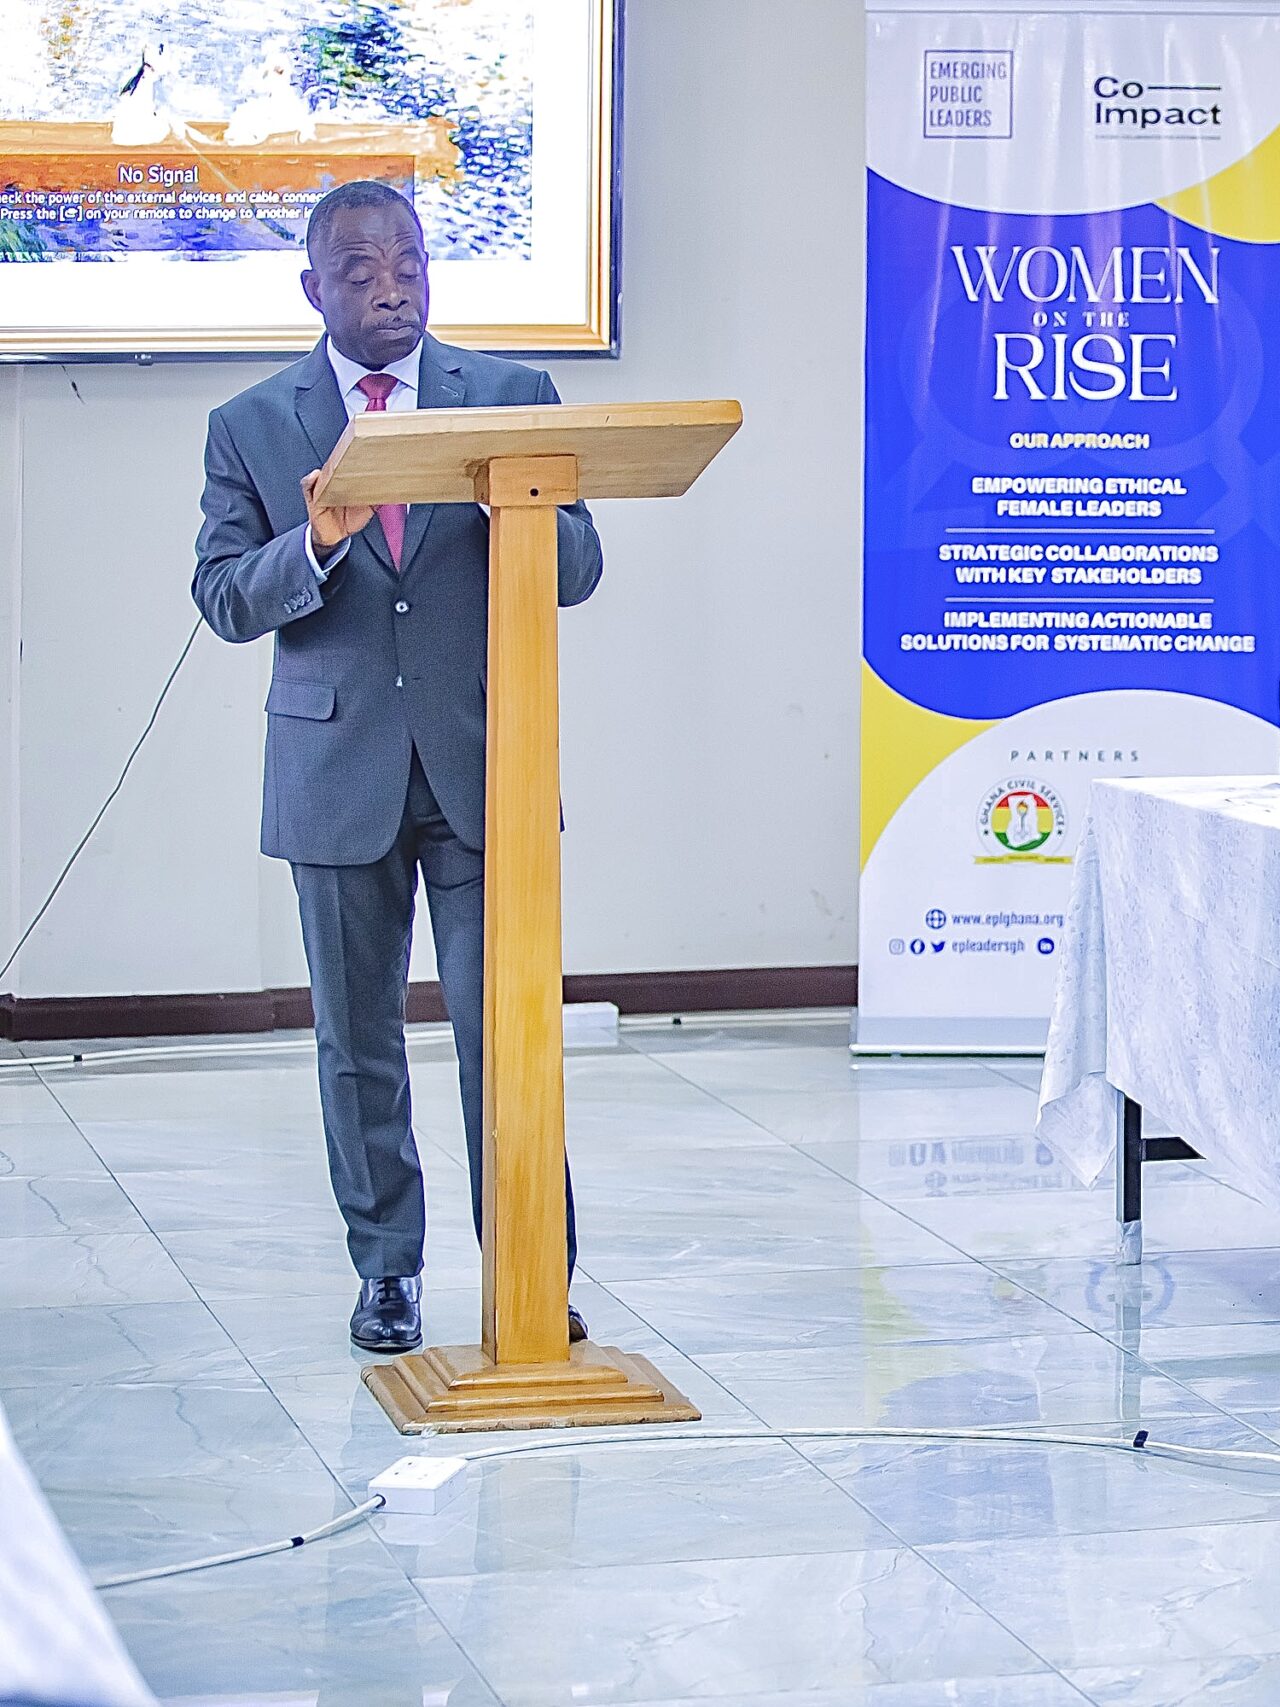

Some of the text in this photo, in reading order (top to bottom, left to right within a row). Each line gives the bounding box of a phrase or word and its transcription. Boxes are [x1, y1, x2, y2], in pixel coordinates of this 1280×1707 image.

[930, 62, 1006, 79] EMERGING
[930, 86, 982, 102] PUBLIC
[929, 110, 991, 126] LEADERS
[1095, 103, 1221, 128] Impact
[120, 166, 198, 187] No Signal
[0, 192, 21, 203] eck
[26, 192, 48, 203] the
[49, 194, 85, 206] power
[88, 192, 101, 203] of
[104, 192, 124, 203] the
[127, 192, 175, 203] external
[179, 192, 222, 203] devices
[226, 192, 246, 203] and
[250, 192, 276, 203] cable
[1, 209, 32, 219] Press
[36, 208, 55, 219] the
[86, 210, 100, 219] on
[104, 210, 130, 221] your
[133, 209, 175, 219] remote
[179, 208, 192, 219] to
[196, 208, 236, 222] change
[240, 208, 252, 219] to
[256, 208, 301, 219] another
[951, 246, 1220, 303] WOMEN
[1033, 312, 1129, 327] ON THE
[993, 333, 1177, 400] RISE
[1010, 434, 1149, 449] OUR APPROACH
[973, 478, 1186, 494] EMPOWERING ETHICAL
[997, 500, 1161, 516] FEMALE LEADERS
[939, 545, 1218, 561] STRATEGIC COLLABORATIONS
[956, 568, 1201, 584] WITH KEY STAKEHOLDERS
[944, 612, 1212, 629] IMPLEMENTING ACTIONABLE
[900, 635, 1255, 652] SOLUTIONS FOR SYSTEMATIC CHANGE
[1010, 751, 1139, 762] PARTNERS
[1007, 780, 1035, 790] CIVIL
[952, 940, 1024, 954] epleadersgh
